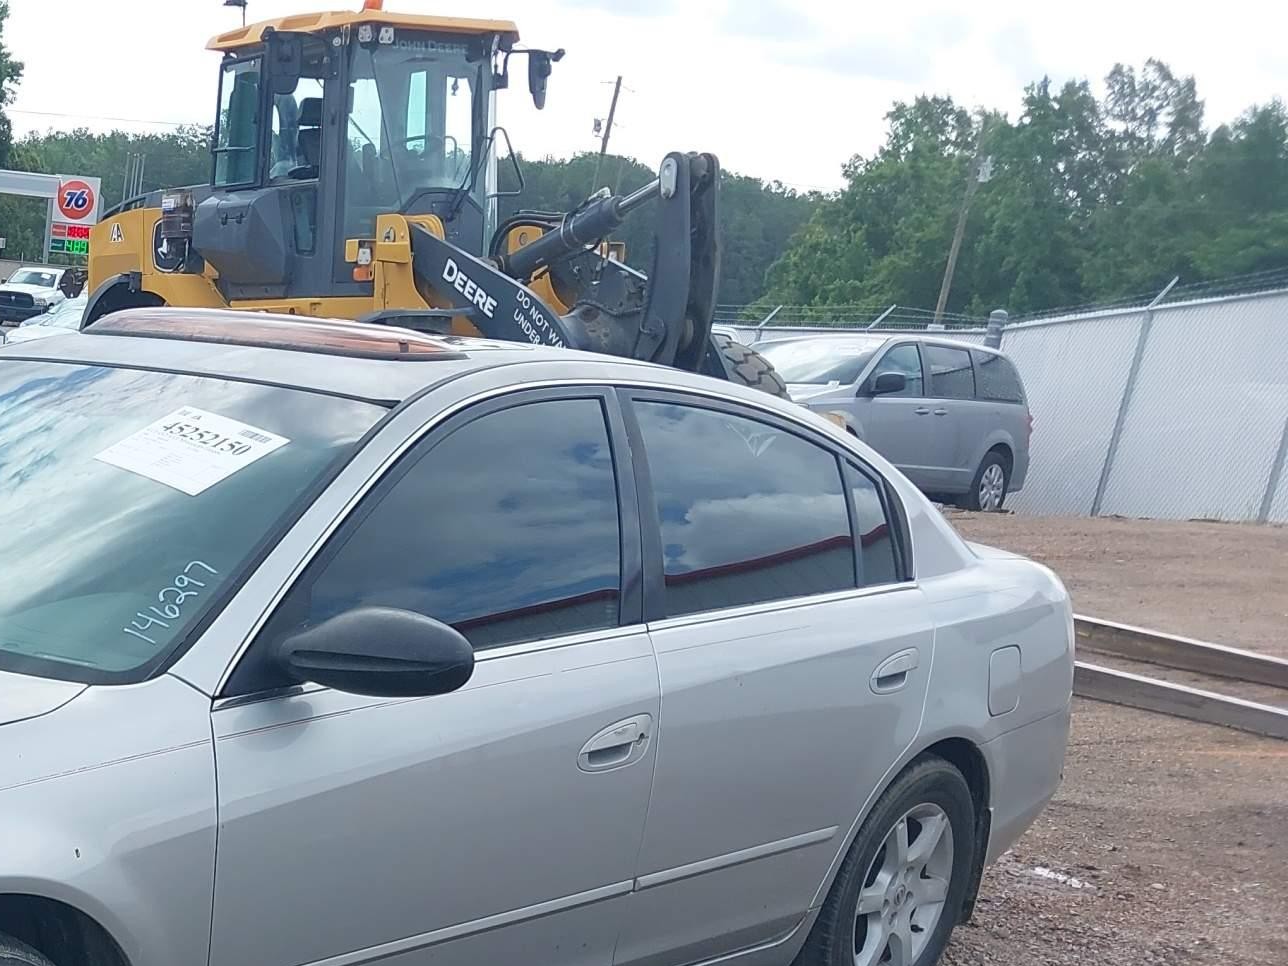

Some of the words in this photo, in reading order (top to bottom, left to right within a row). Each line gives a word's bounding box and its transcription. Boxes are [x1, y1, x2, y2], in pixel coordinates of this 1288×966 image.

[63, 190, 89, 211] 76
[442, 258, 498, 318] DEERE
[516, 289, 531, 309] DO
[529, 307, 550, 332] NOT
[163, 421, 253, 457] 45252150
[123, 559, 219, 645] 146297
